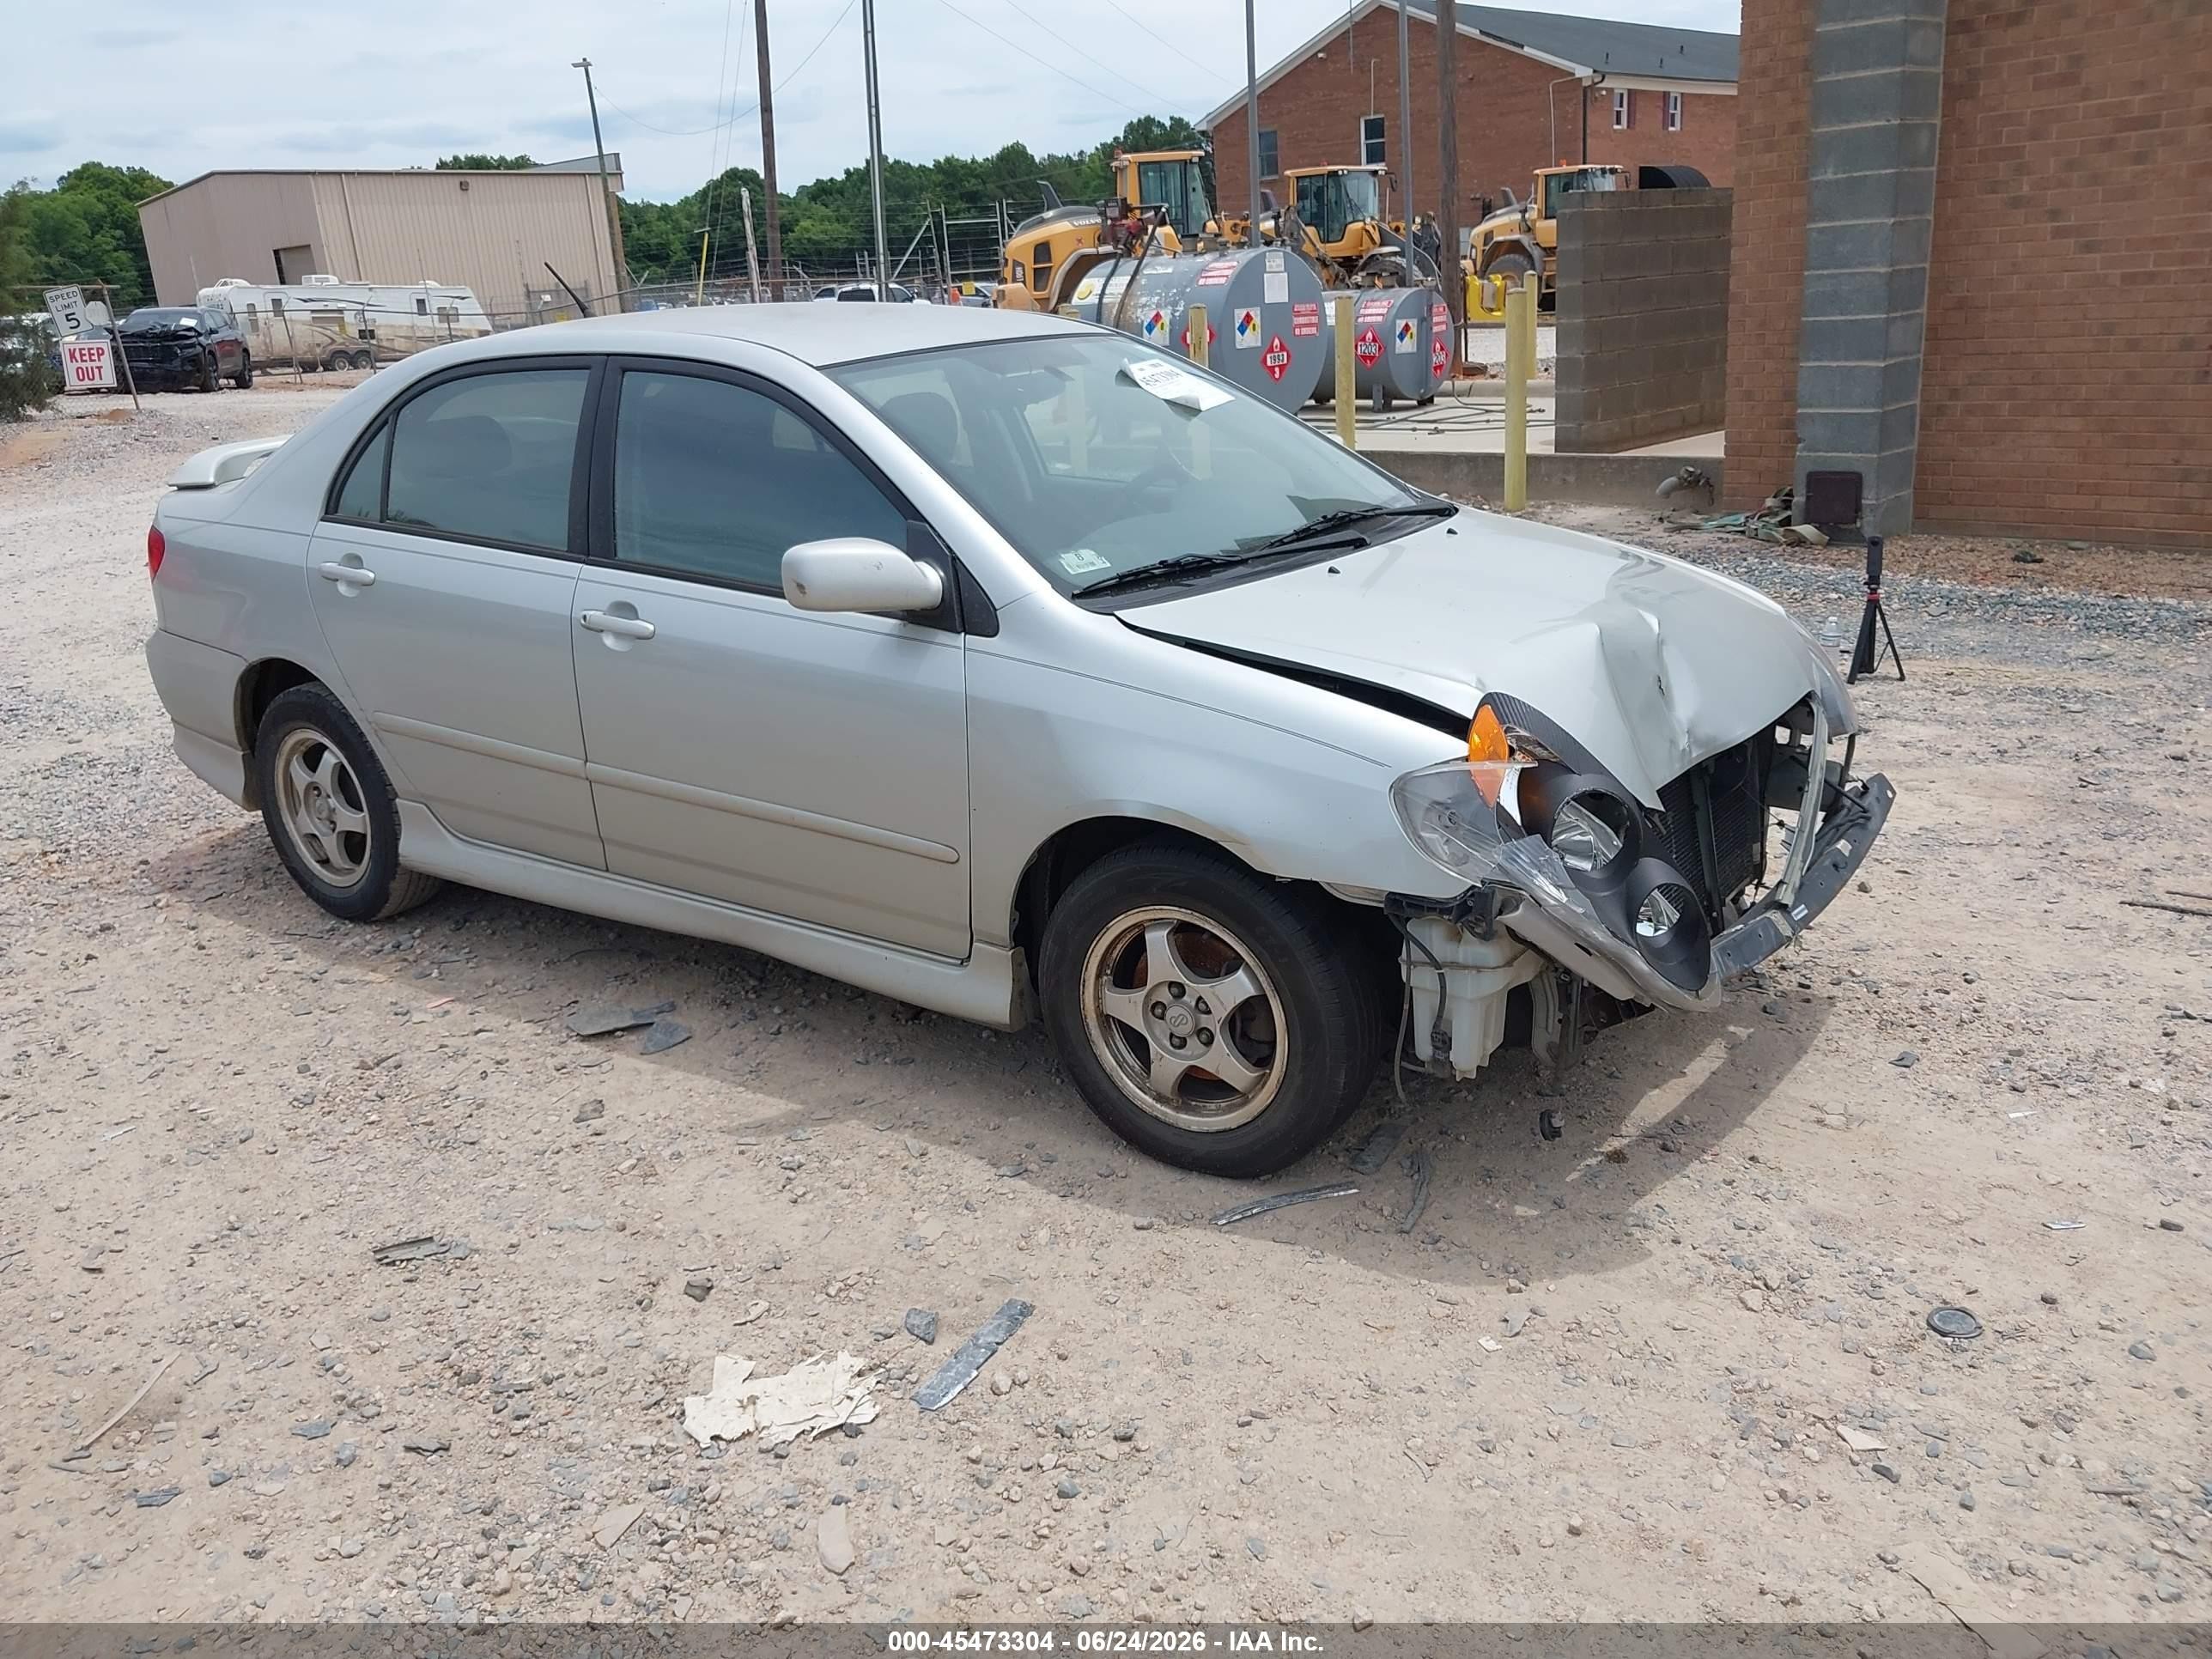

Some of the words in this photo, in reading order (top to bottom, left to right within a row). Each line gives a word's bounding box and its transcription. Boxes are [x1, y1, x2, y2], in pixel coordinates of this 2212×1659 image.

[1073, 218, 1103, 227] VOLVO
[49, 291, 78, 303] SPEED
[55, 301, 78, 312] LIMIT
[65, 313, 81, 330] 5
[68, 347, 105, 363] KEEP
[1359, 343, 1377, 355] 1203
[1269, 354, 1285, 365] 1993
[76, 366, 103, 382] OUT
[1274, 367, 1279, 379] 3
